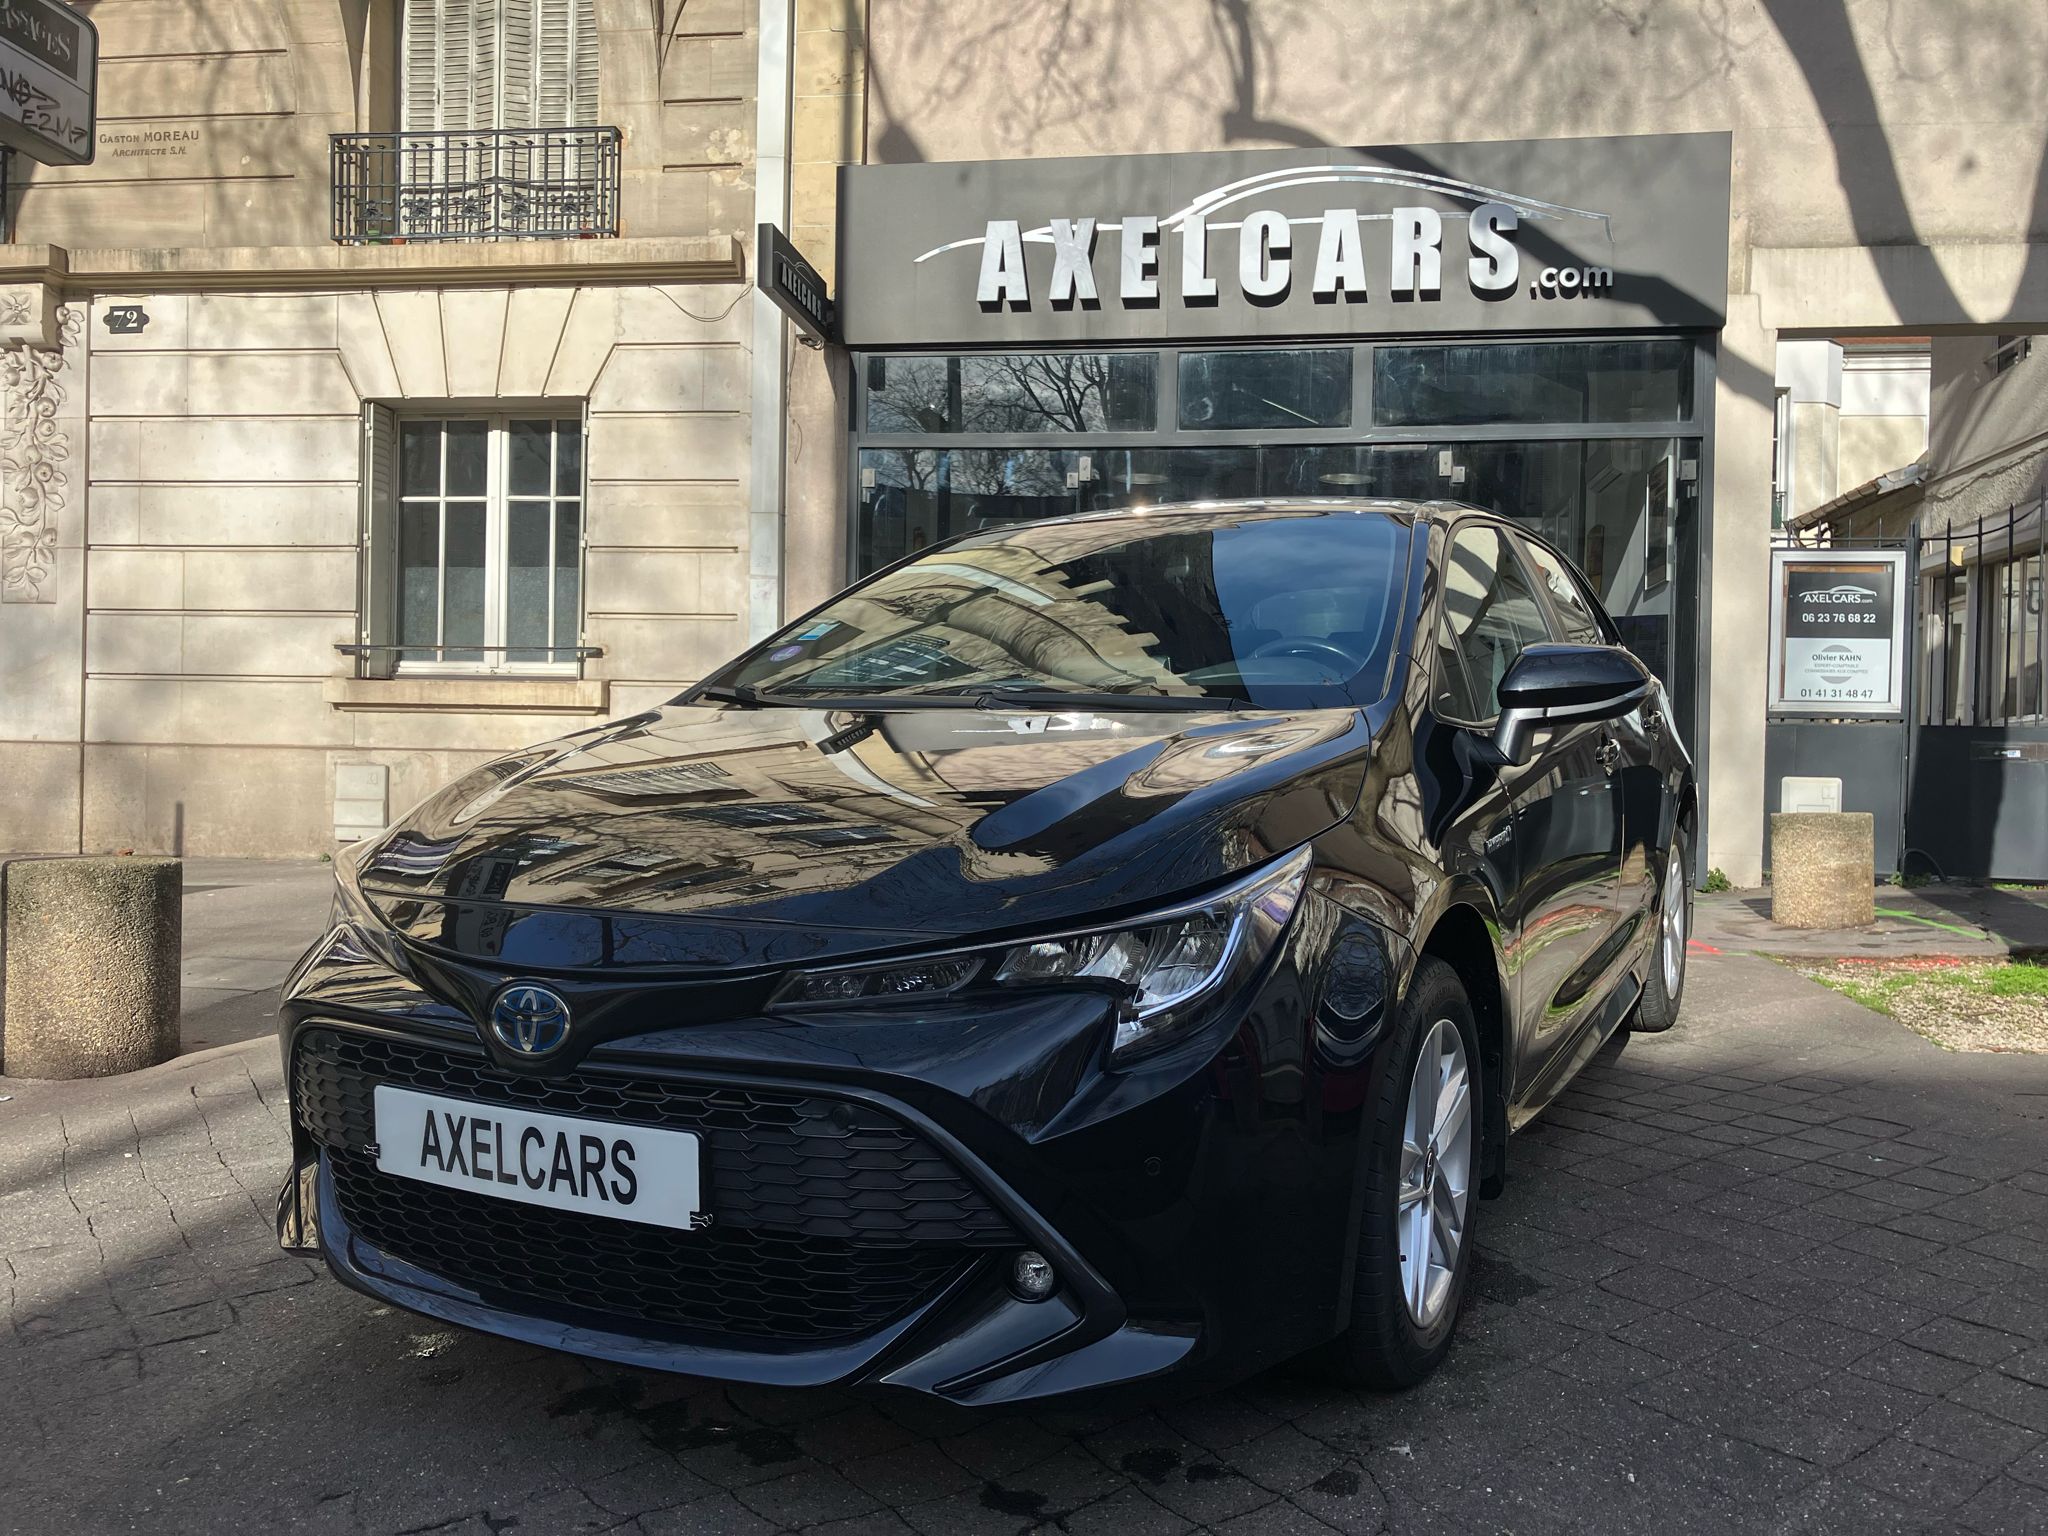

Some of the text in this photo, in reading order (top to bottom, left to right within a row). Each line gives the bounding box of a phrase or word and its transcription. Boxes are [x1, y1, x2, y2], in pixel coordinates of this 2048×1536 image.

[144, 130, 199, 142] MOREAU
[113, 310, 138, 328] 72
[1802, 613, 1876, 624] 06 23 76 68 22
[1839, 654, 1862, 662] KAHN
[1801, 689, 1873, 699] 01 41 31 48 47
[420, 1109, 638, 1206] AXELCARS
